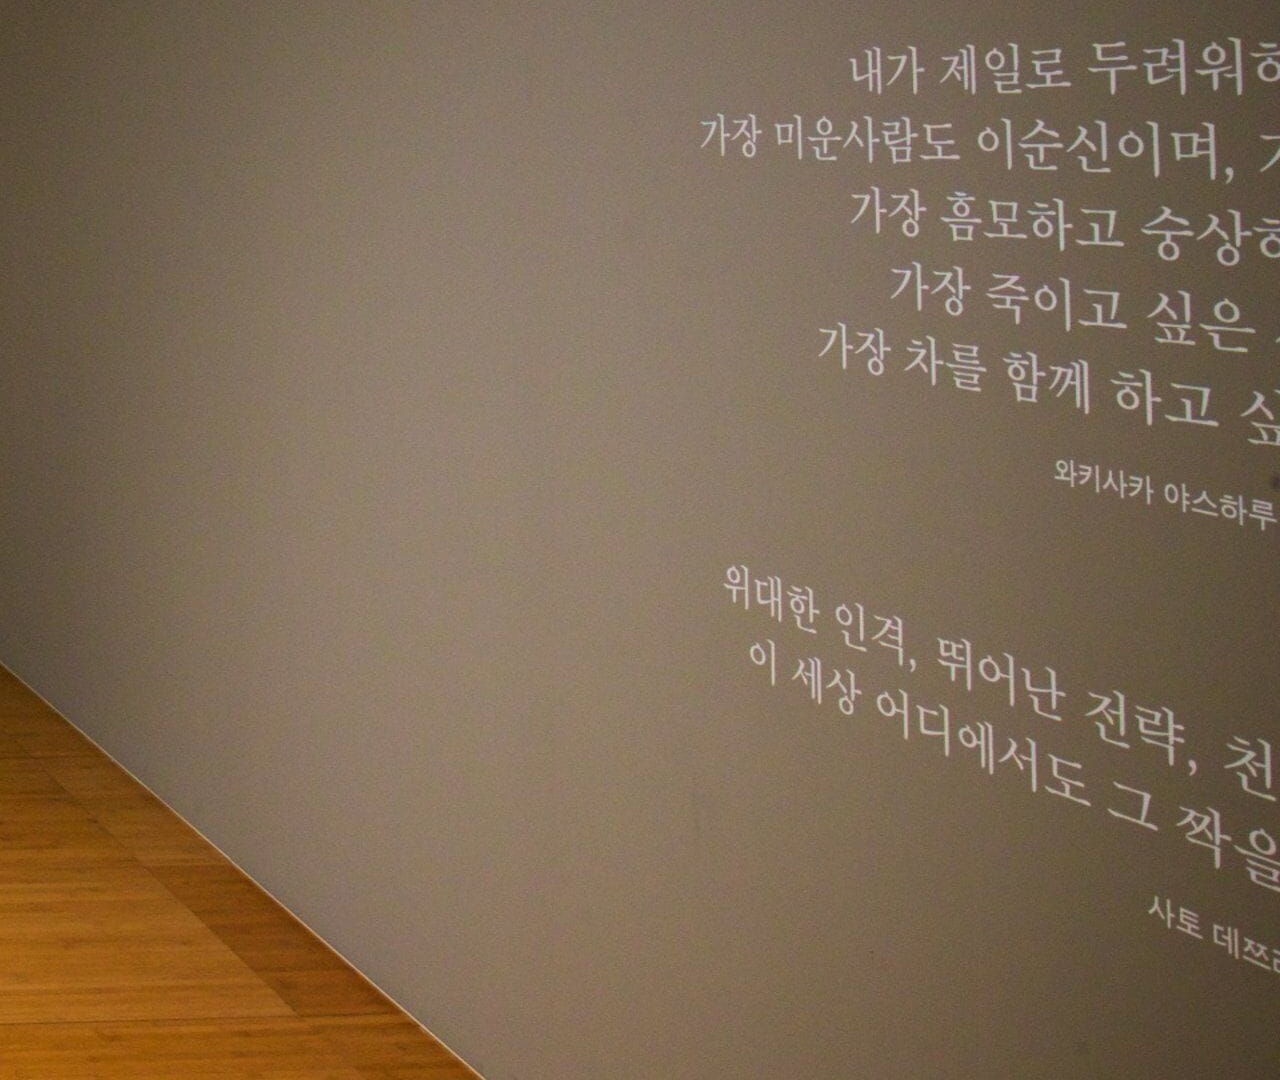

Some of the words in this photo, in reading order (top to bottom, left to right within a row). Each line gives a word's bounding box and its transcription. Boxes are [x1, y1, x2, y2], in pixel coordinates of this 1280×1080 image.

[850, 46, 924, 94] 내가
[941, 43, 1071, 94] 제일로
[701, 113, 762, 158] 가장
[775, 114, 960, 163] 미운사람도
[978, 118, 1234, 183] 이순신이며,
[851, 186, 926, 237] 가장
[941, 192, 1124, 251] 흠모하고
[891, 262, 971, 316] 가장
[987, 274, 1127, 331] 죽이고
[1148, 291, 1255, 353] 싶은
[819, 322, 891, 376] 가장
[905, 336, 986, 392] 차를
[1004, 352, 1089, 414] 함께
[1111, 369, 1219, 427] 하고
[1054, 460, 1154, 504] 와키사카
[1164, 483, 1277, 530] 야스하루
[724, 565, 820, 634] 위대한
[835, 603, 916, 672] 인격,
[938, 638, 1066, 722] 뛰어난
[1086, 691, 1197, 775] 전략,
[750, 640, 776, 685] 이
[792, 658, 862, 715] 세상
[876, 688, 1091, 806] 어디에서도
[1108, 782, 1158, 831] 그
[1177, 807, 1280, 892] 짝을
[1148, 896, 1203, 939] 사토
